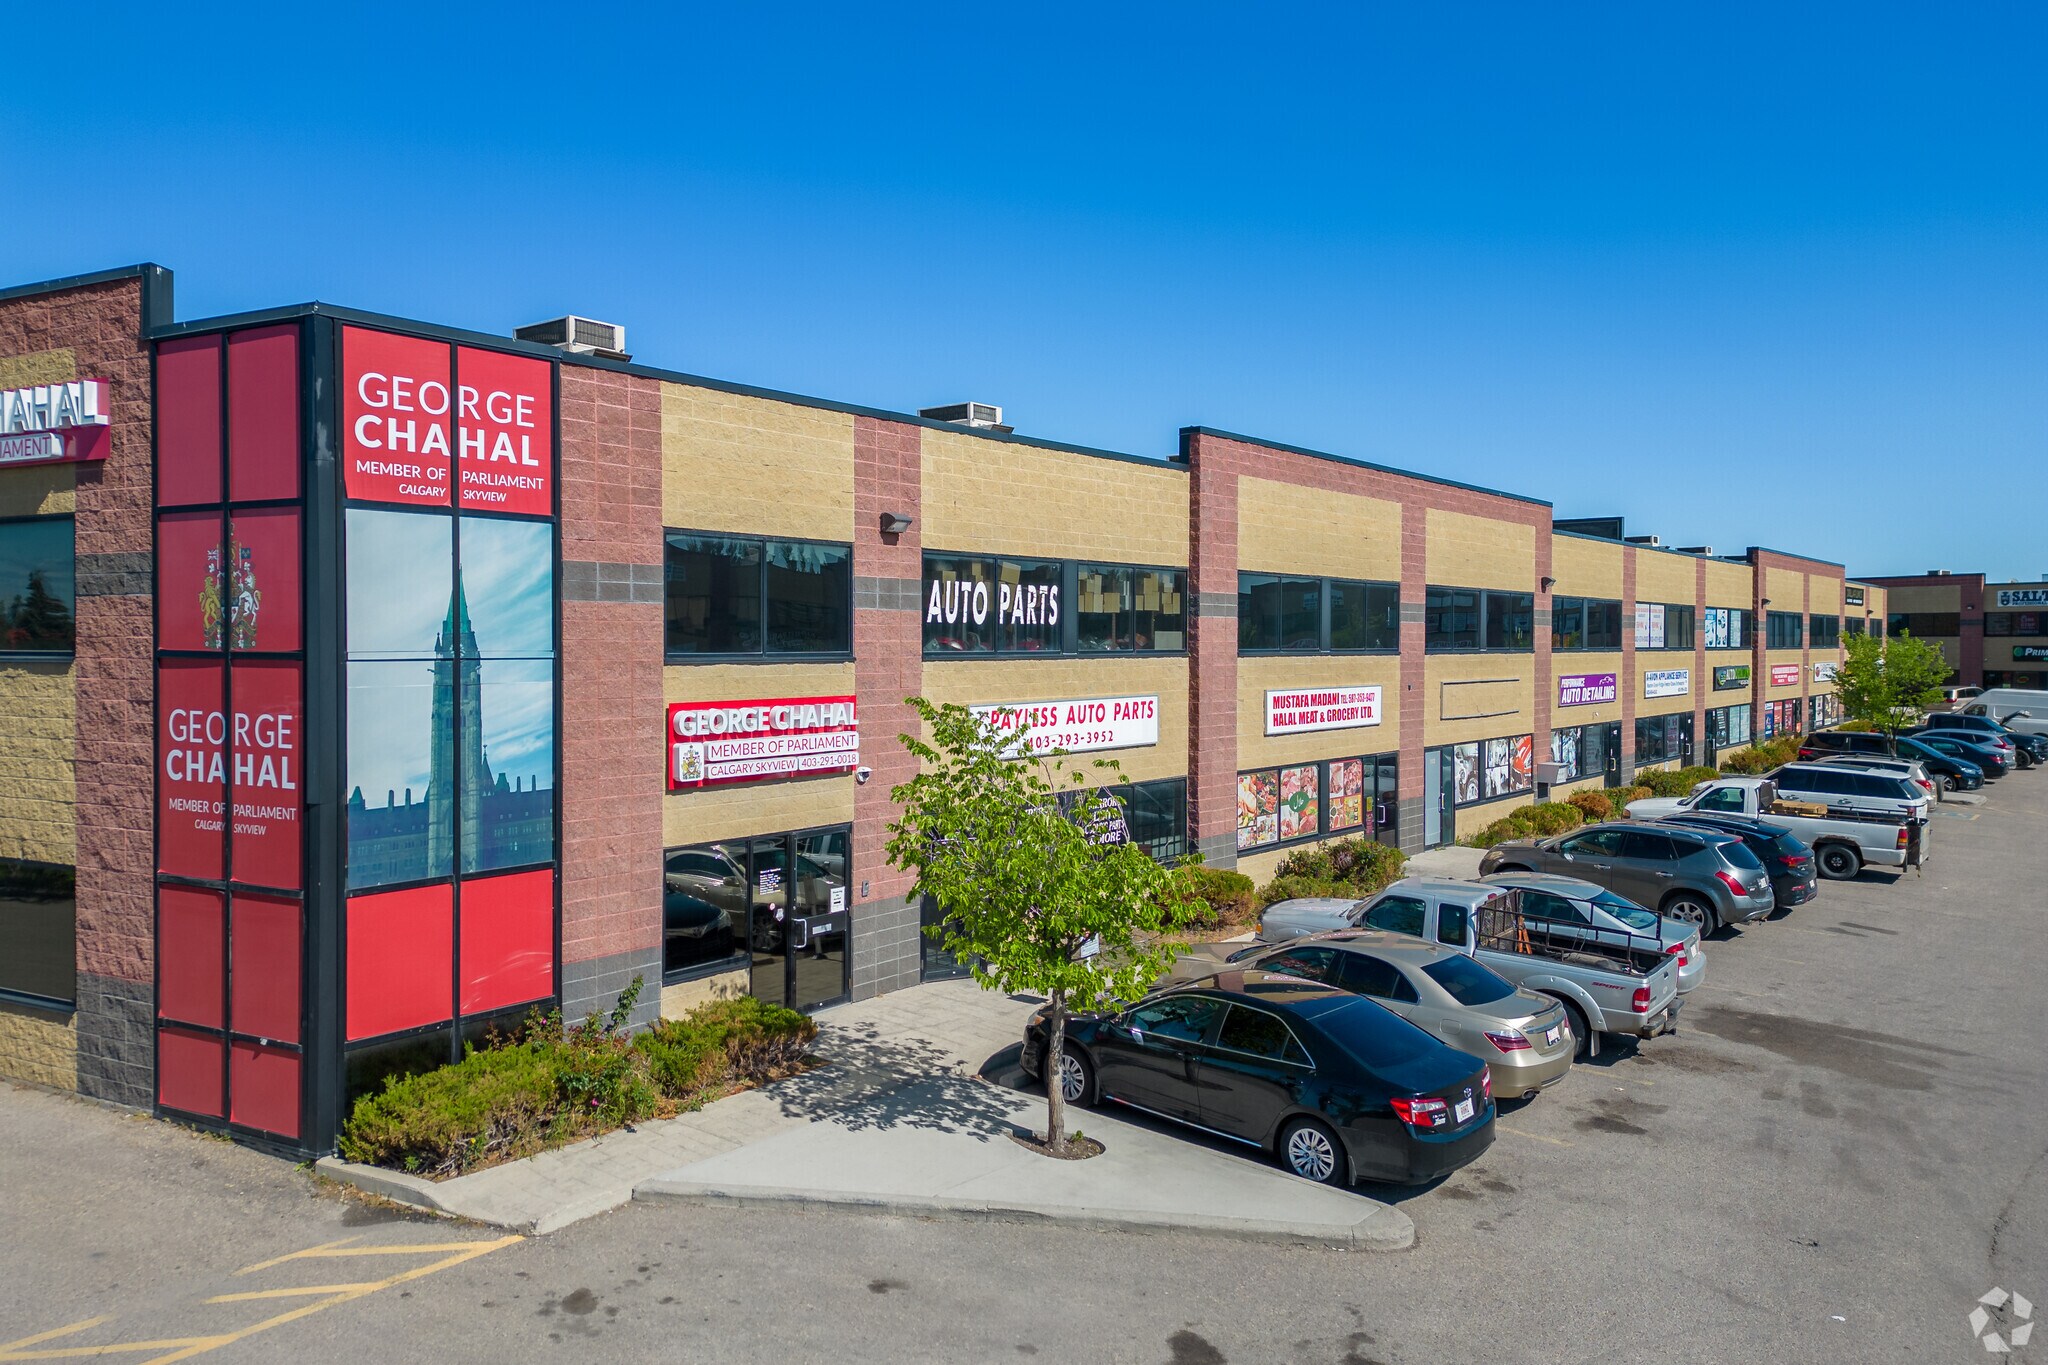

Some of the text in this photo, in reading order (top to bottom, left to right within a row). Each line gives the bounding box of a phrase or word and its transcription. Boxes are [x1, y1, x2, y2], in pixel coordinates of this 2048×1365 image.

[0, 380, 108, 434] AHAL
[357, 372, 535, 428] GEORGE
[354, 414, 539, 467] CHAHAL
[356, 459, 544, 490] MEMBER OF PARLIAMENT
[398, 483, 507, 503] CALGARY SKYVIEW
[926, 579, 1059, 626] AUTO PARTS
[1272, 694, 1310, 710] MUSTAFA
[1310, 692, 1340, 707] MADANI
[1561, 685, 1615, 704] AUTO DETAILING
[673, 702, 859, 736] GEORGE CHAHAL
[990, 700, 1154, 730] PAYLESS AUTO PARTS
[1272, 706, 1374, 727] HALAL MEAT & GROCERY LTD.
[168, 708, 293, 749] GEORGE
[1028, 730, 1114, 750] 403-293-3952
[711, 734, 856, 758] MEMBER OF PARLIAMENT
[166, 749, 296, 790] CHAHAL
[710, 759, 796, 777] CALGARY SKYVIEW
[801, 753, 857, 768] 403-291-0018
[168, 797, 297, 821] MEMBER OF PARLIAMENT
[194, 818, 267, 836] CALGARY SKYVIEW
[1097, 829, 1121, 845] MORE
[1591, 981, 1626, 991] SPORT
